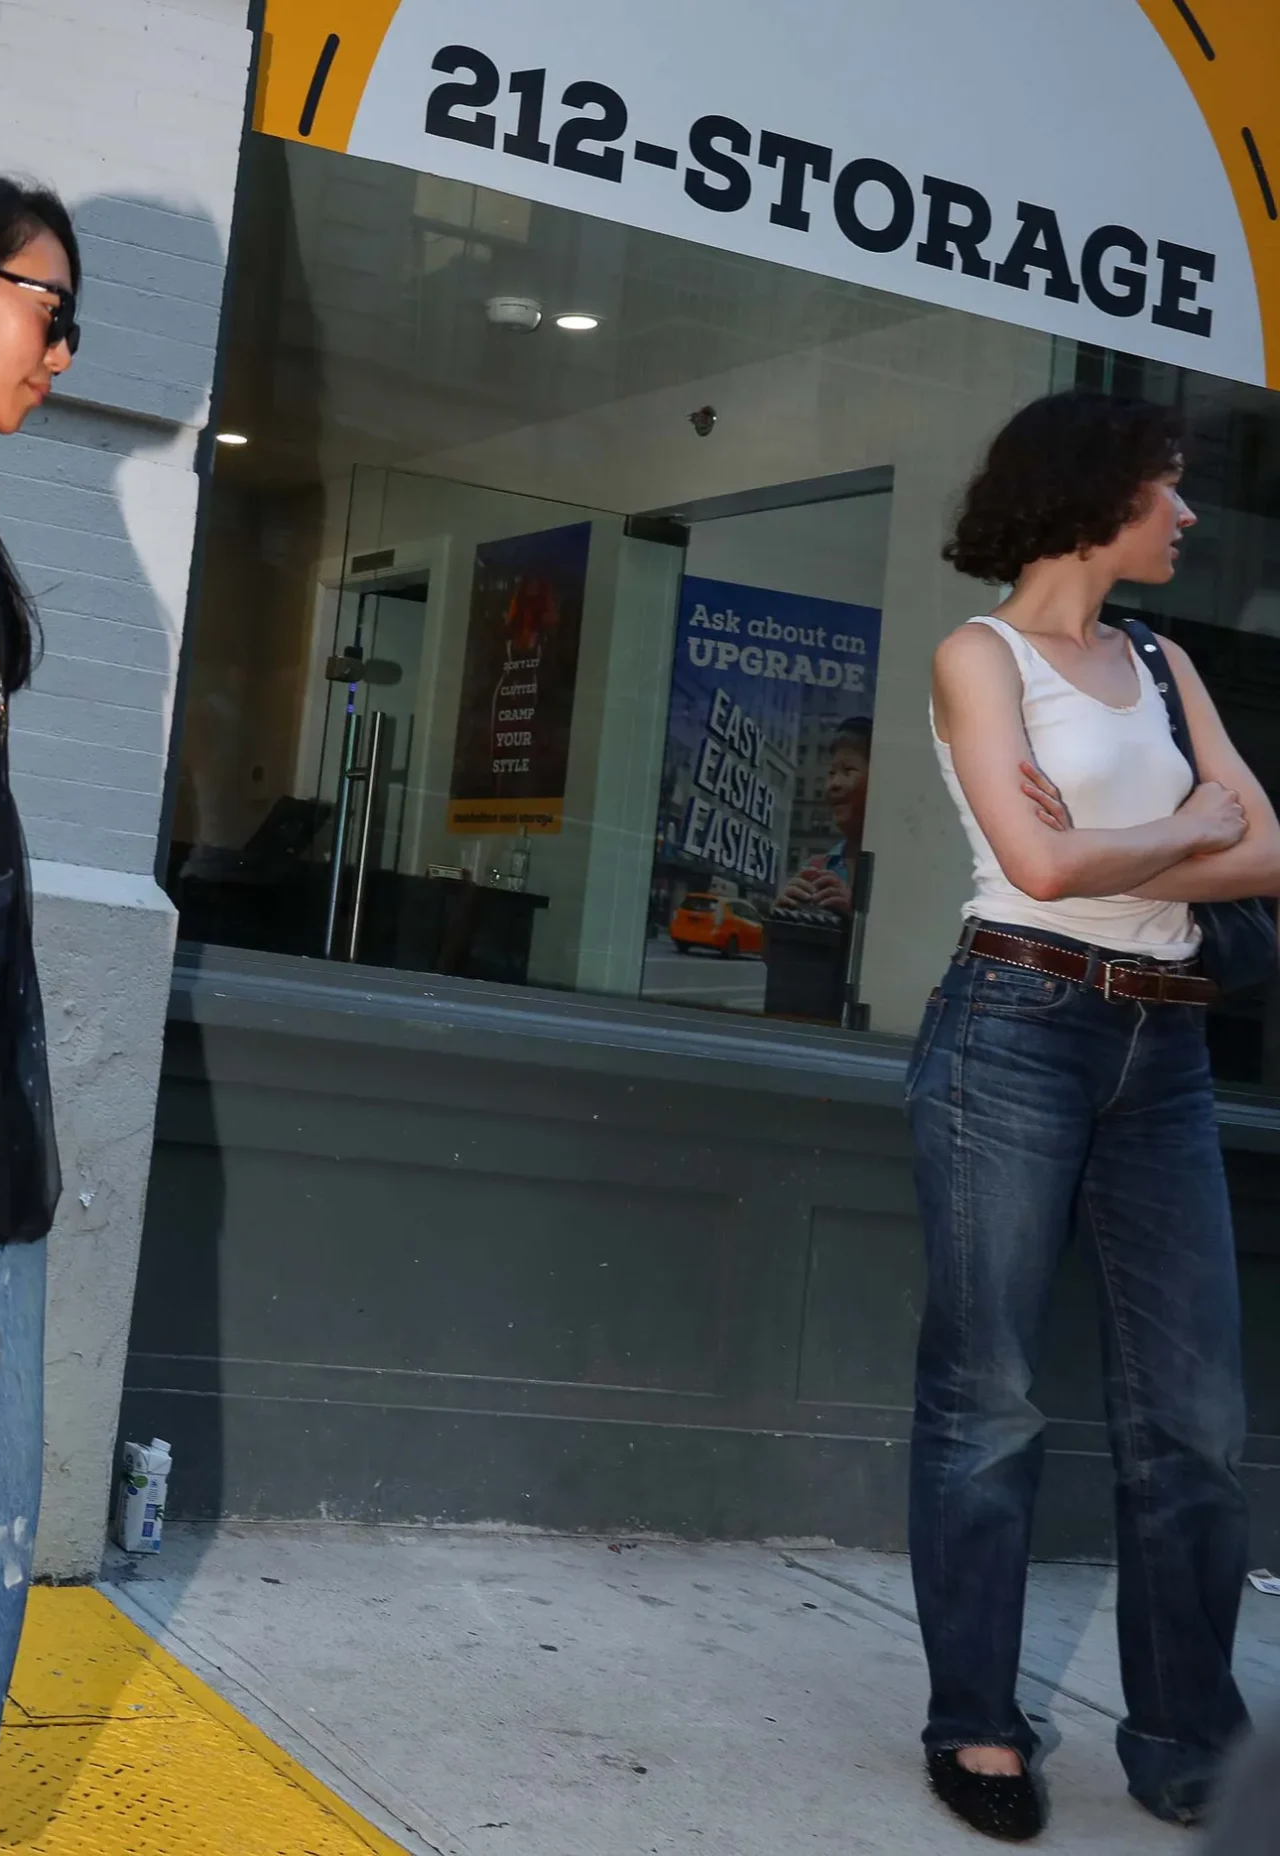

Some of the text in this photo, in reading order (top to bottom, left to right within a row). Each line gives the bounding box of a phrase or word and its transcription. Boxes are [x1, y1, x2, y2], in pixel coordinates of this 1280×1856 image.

[425, 45, 1217, 338] 212-STORAGE
[688, 603, 867, 656] Ask about an
[500, 684, 537, 696] CLUTTER
[687, 636, 866, 692] UPGRADE
[495, 732, 532, 747] YOUR
[497, 708, 535, 721] CRAMP
[708, 686, 768, 768] EASY
[492, 758, 530, 774] STYLE
[696, 737, 777, 831] EASIER
[682, 795, 780, 885] EASIEST
